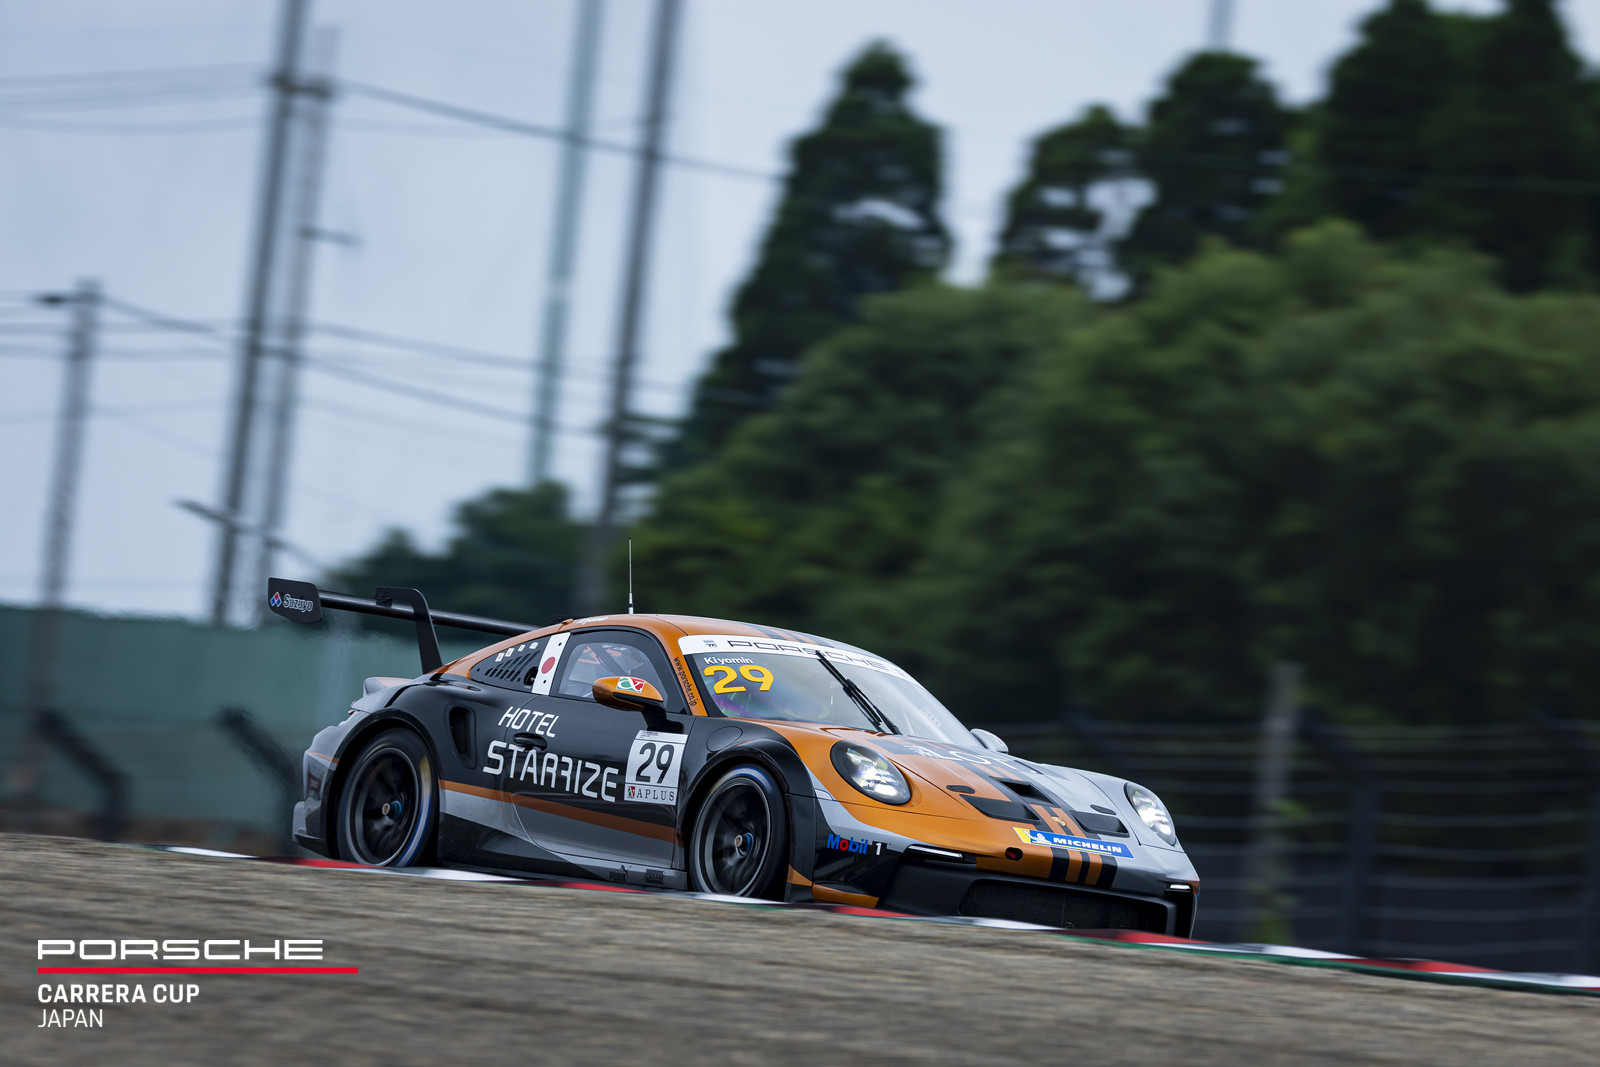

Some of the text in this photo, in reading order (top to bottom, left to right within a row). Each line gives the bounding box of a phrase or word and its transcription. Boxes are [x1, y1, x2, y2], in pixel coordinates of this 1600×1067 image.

[283, 593, 313, 613] Suzuyo
[727, 640, 889, 672] PORSCHE
[673, 656, 698, 708] www.porsche.co.jp
[703, 664, 774, 694] 29
[498, 706, 559, 738] HOTEL
[635, 742, 675, 784] 29
[636, 788, 675, 802] APLUS
[826, 833, 882, 856] Mobil 1
[1053, 836, 1123, 854] MICHELIN
